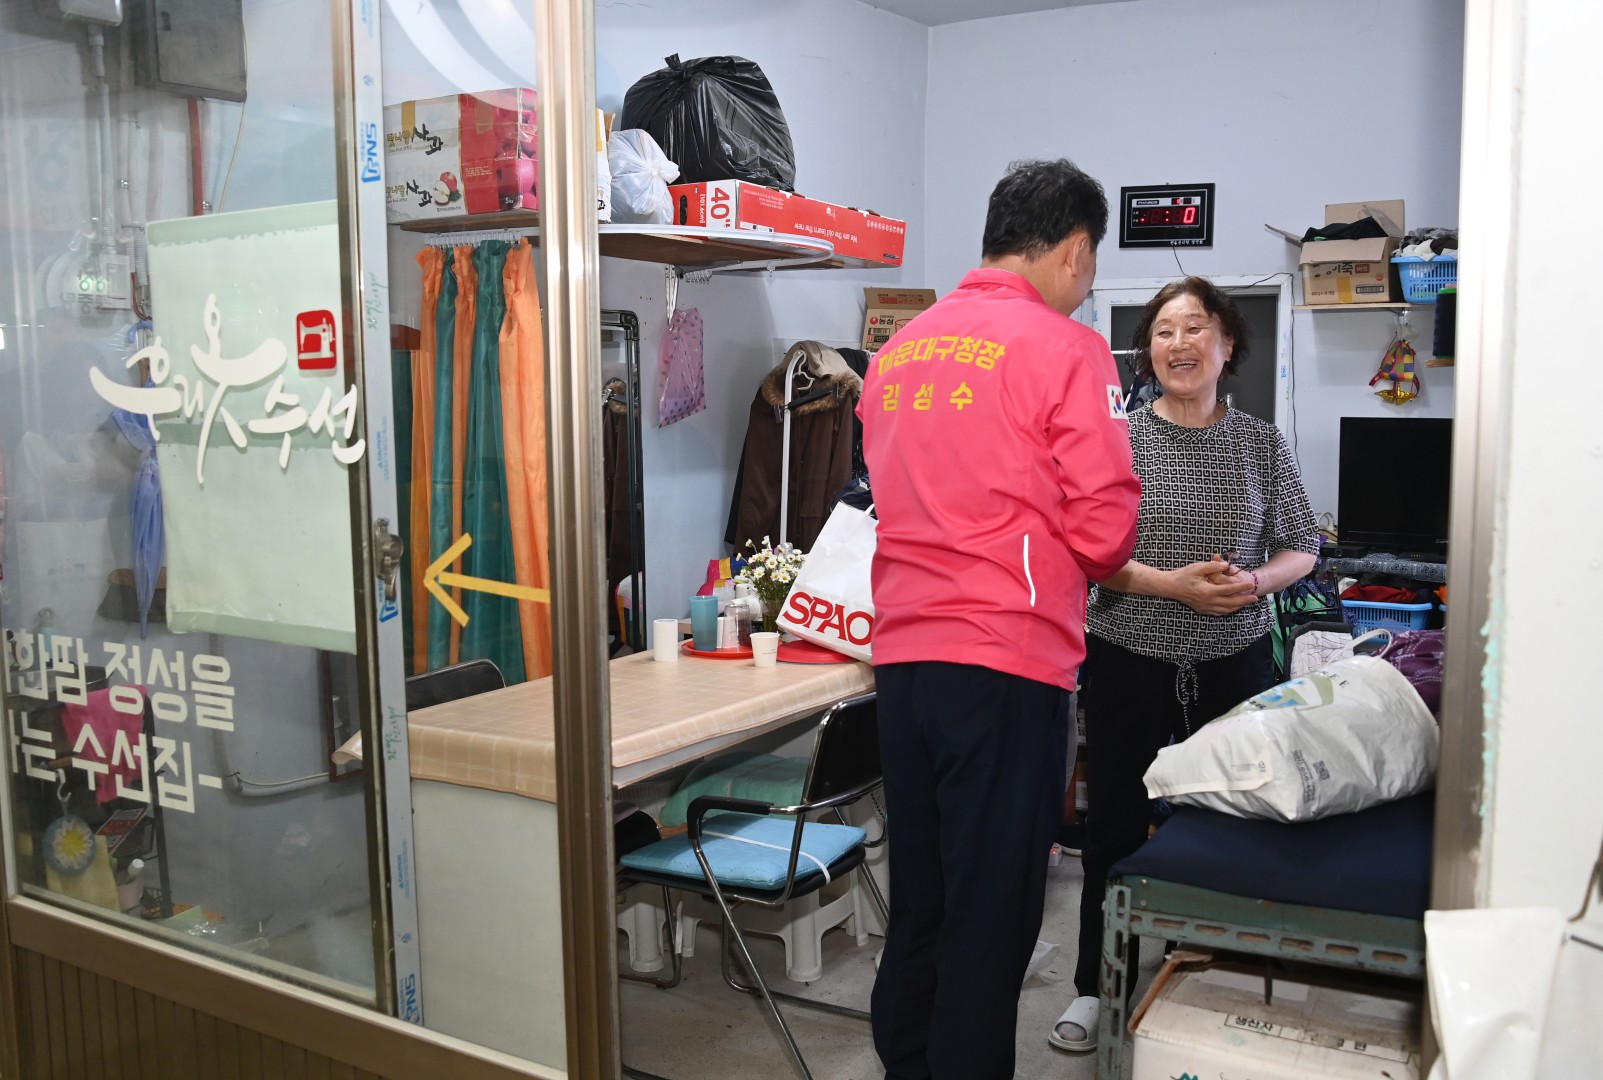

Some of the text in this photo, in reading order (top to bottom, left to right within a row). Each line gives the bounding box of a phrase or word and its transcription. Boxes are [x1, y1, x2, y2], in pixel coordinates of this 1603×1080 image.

[794, 222, 805, 231] new
[804, 224, 813, 234] the
[826, 229, 835, 238] old
[835, 230, 843, 239] the
[782, 591, 875, 646] SPAO
[3, 628, 235, 732] 한땀 정성을
